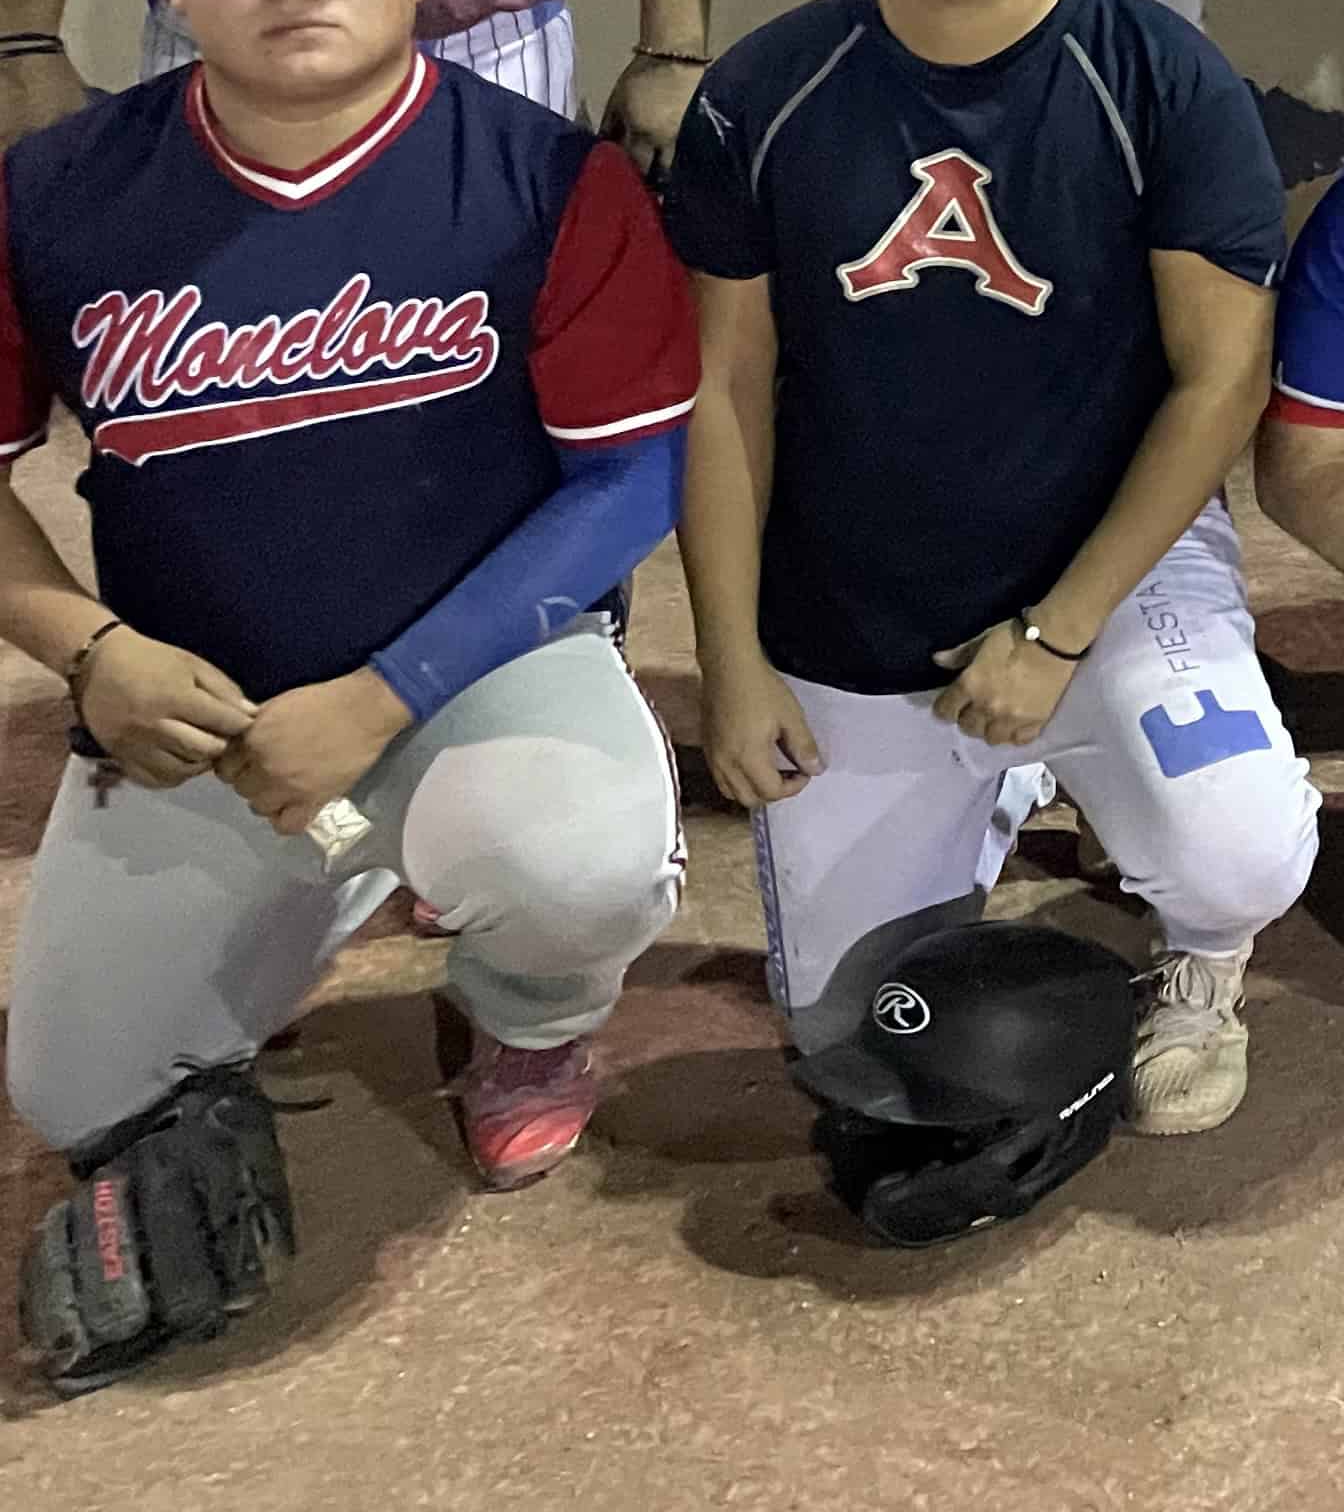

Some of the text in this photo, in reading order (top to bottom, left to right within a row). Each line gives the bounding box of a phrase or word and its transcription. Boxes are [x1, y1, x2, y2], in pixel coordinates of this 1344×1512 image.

[836, 147, 1054, 316] A
[73, 272, 492, 411] Monclova
[1135, 581, 1201, 673] FIESTA
